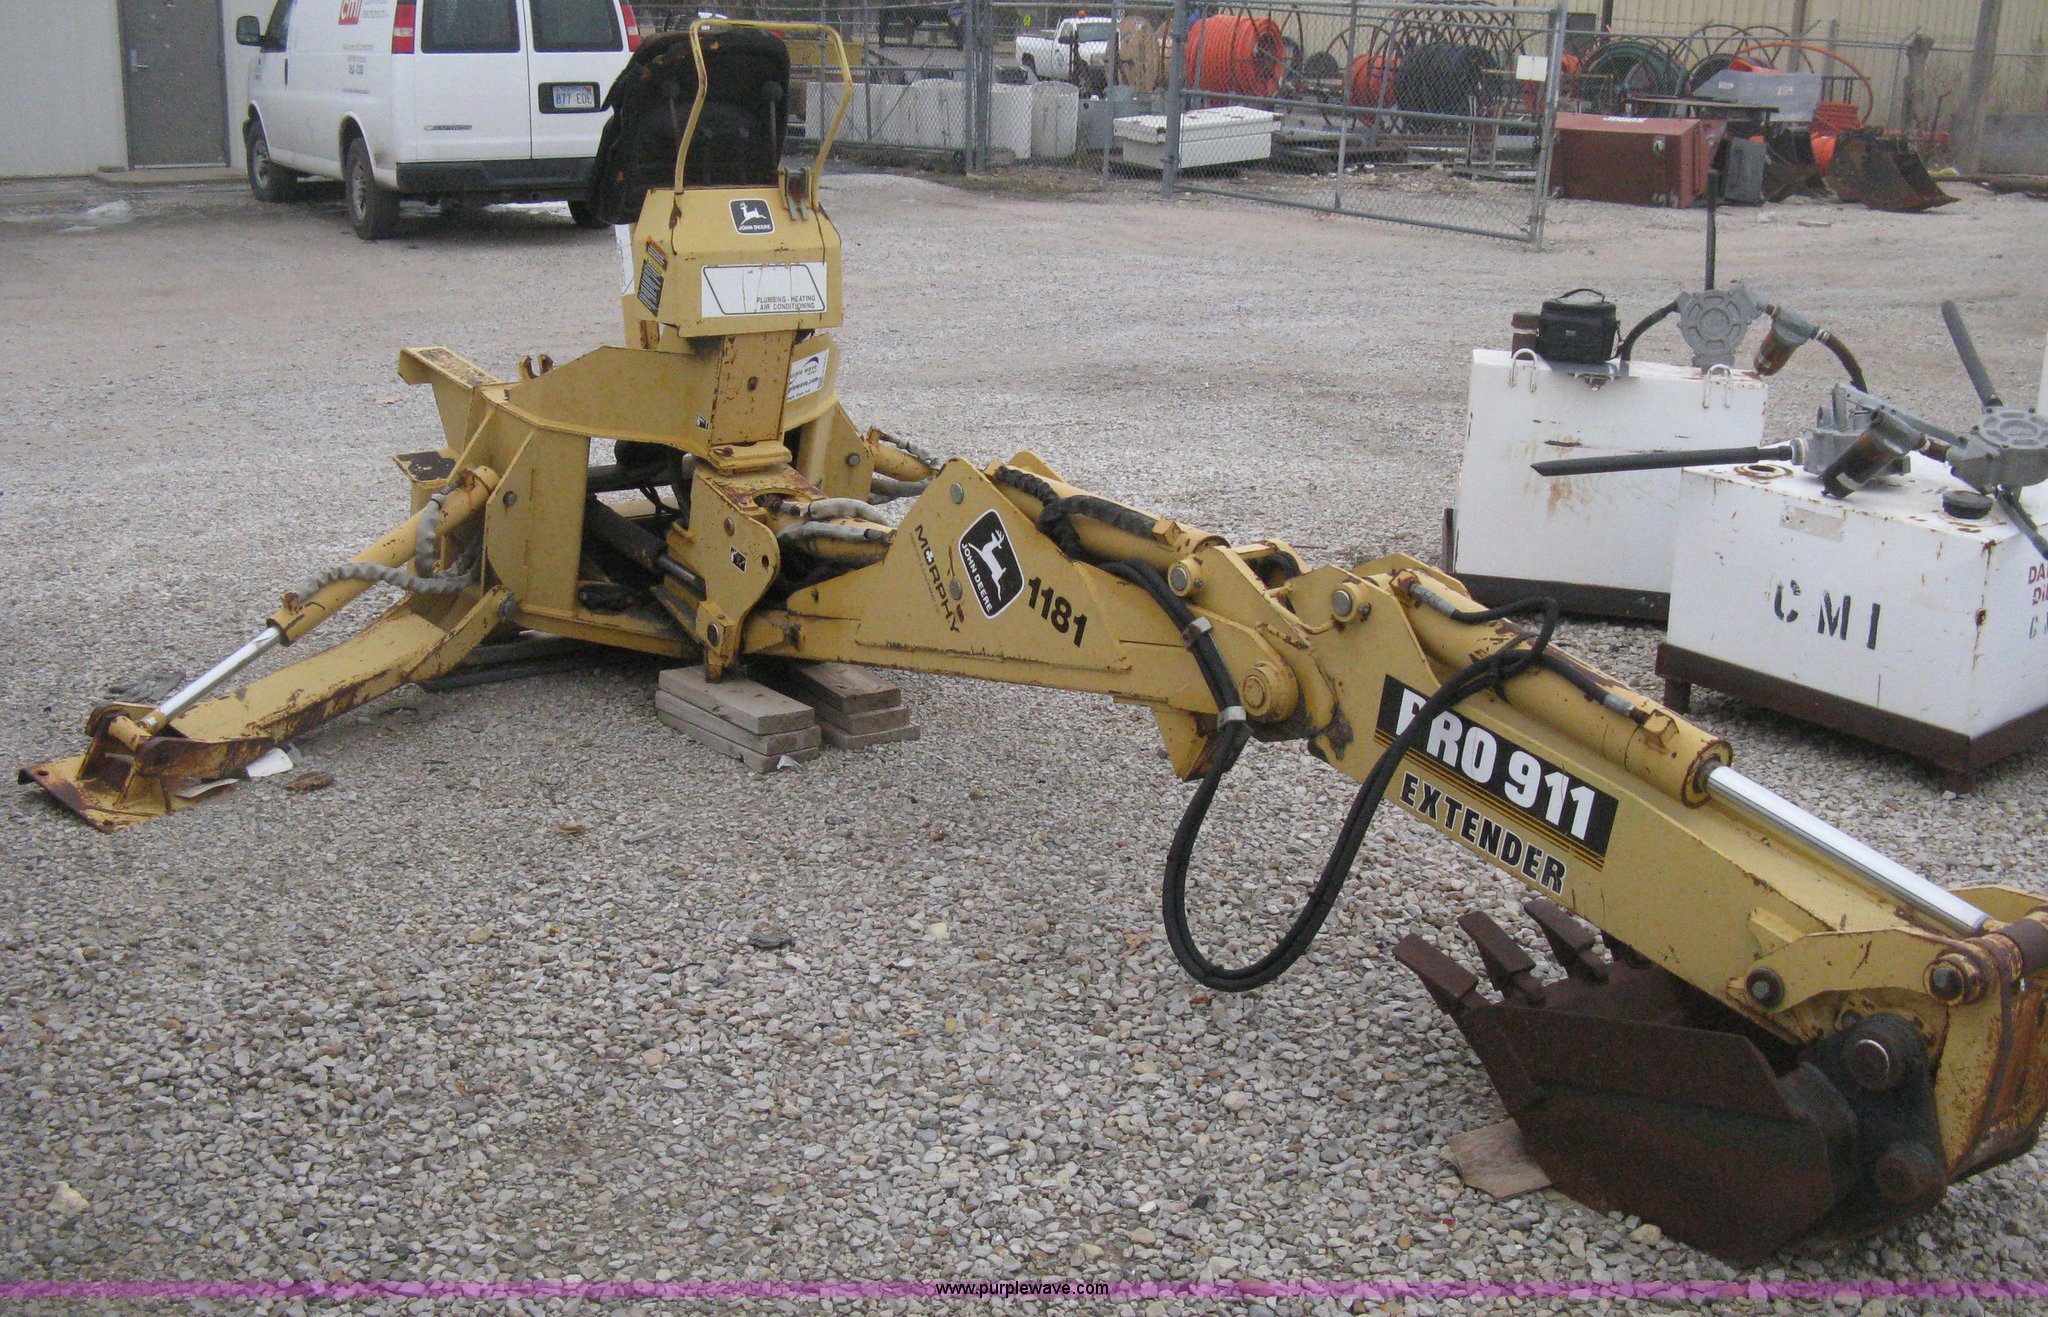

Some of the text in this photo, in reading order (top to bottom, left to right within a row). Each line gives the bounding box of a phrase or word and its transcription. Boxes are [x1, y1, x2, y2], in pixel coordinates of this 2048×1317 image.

[756, 296, 786, 304] PLUMBING
[791, 294, 816, 302] HEATING
[760, 302, 815, 311] AIR CONDITIONING
[961, 543, 993, 613] JOHN DEERE
[2028, 562, 2048, 584] DA
[1028, 576, 1088, 648] 1181
[1504, 750, 1596, 841] 911
[1400, 771, 1567, 897] EXTENDER
